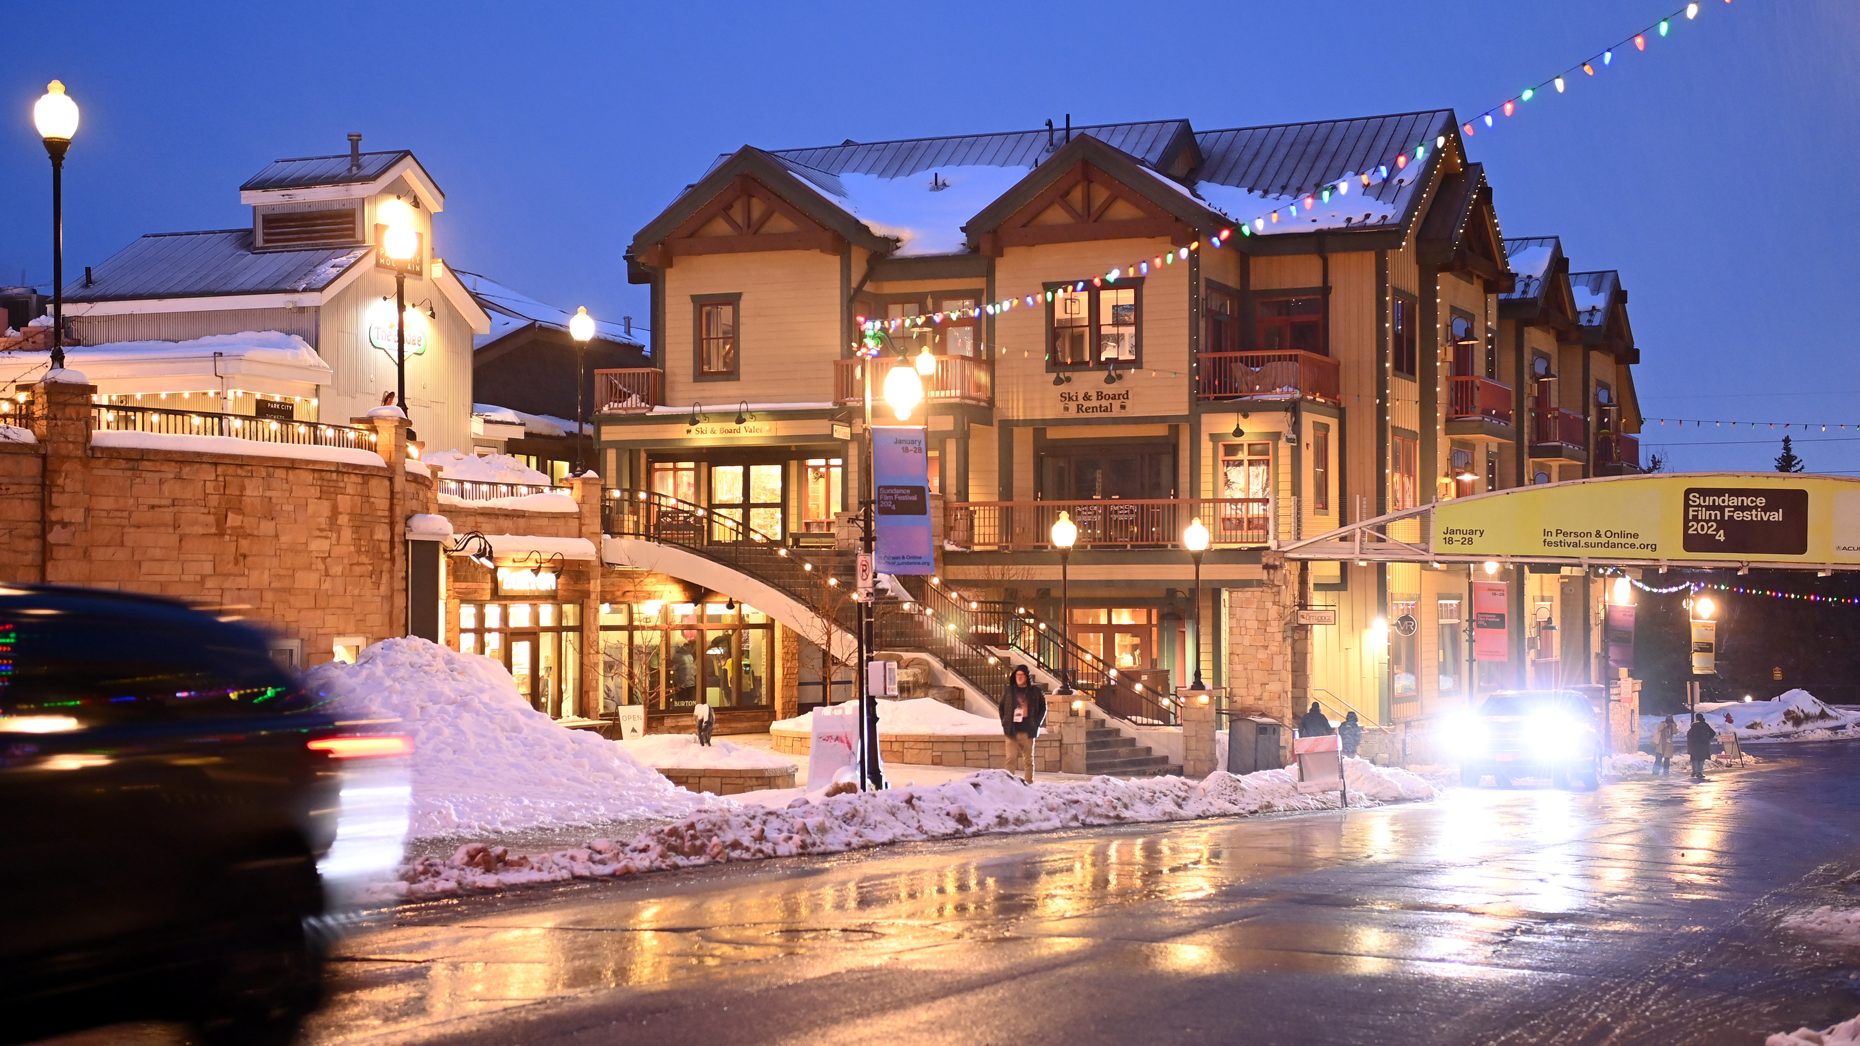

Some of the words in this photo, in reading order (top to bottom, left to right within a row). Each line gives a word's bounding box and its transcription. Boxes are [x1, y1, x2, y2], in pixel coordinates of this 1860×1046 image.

[1060, 391, 1079, 402] Ski
[1082, 391, 1093, 402] &
[1096, 390, 1130, 401] Board
[1076, 402, 1113, 414] Rental
[694, 427, 708, 435] Ski
[720, 426, 741, 434] Board
[744, 426, 762, 434] Valet
[894, 438, 922, 446] January
[880, 501, 896, 510] 2024
[1688, 492, 1766, 507] Sundance
[1688, 508, 1720, 520] Film
[1724, 508, 1783, 522] Festival
[1442, 526, 1485, 538] January
[1543, 528, 1553, 538] In
[1555, 529, 1593, 538] Person
[1594, 530, 1602, 538] &
[1604, 530, 1640, 540] Online
[1688, 522, 1726, 542] 2024
[1442, 537, 1474, 546] 18–28
[1543, 539, 1658, 552] festival.sundance.org
[1399, 620, 1414, 630] VR
